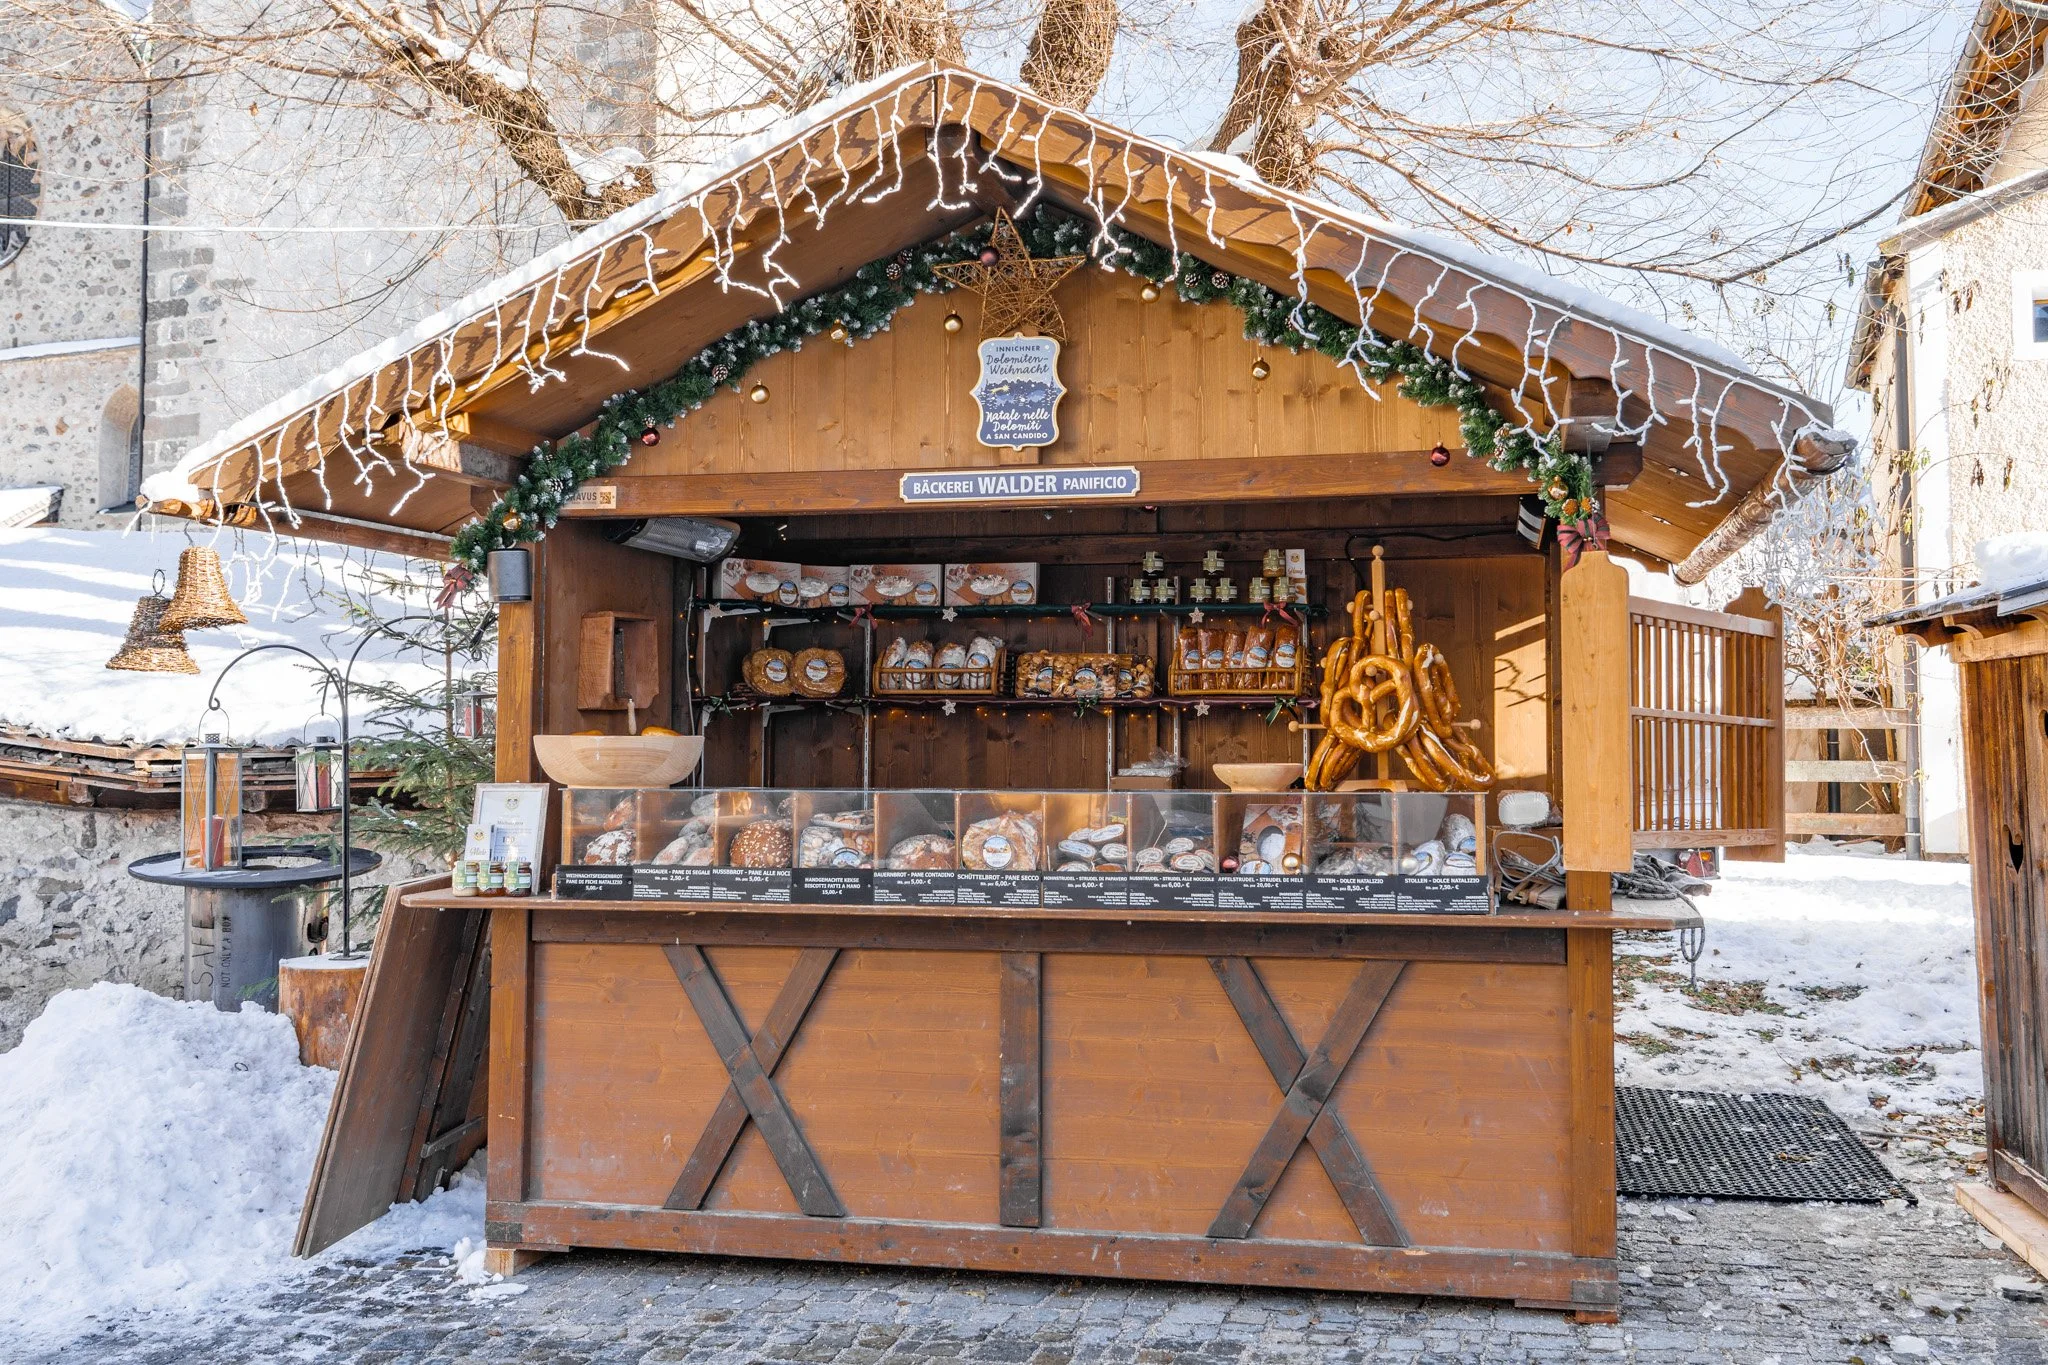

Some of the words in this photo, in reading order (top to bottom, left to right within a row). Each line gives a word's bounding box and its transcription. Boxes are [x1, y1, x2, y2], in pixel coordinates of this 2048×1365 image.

[986, 354, 1049, 366] Dolomiten-
[990, 364, 1050, 376] Weihnacht
[986, 408, 1020, 422] Natale
[1022, 408, 1050, 420] nelle
[992, 420, 1042, 432] Dolomiti
[914, 478, 974, 494] BÄCKEREI
[978, 474, 1057, 494] WALDER
[1063, 476, 1127, 490] PANIFICIO
[221, 916, 232, 933] BOX
[191, 913, 215, 988] SAFE
[220, 947, 232, 968] ONLY
[221, 972, 232, 988] NOT
